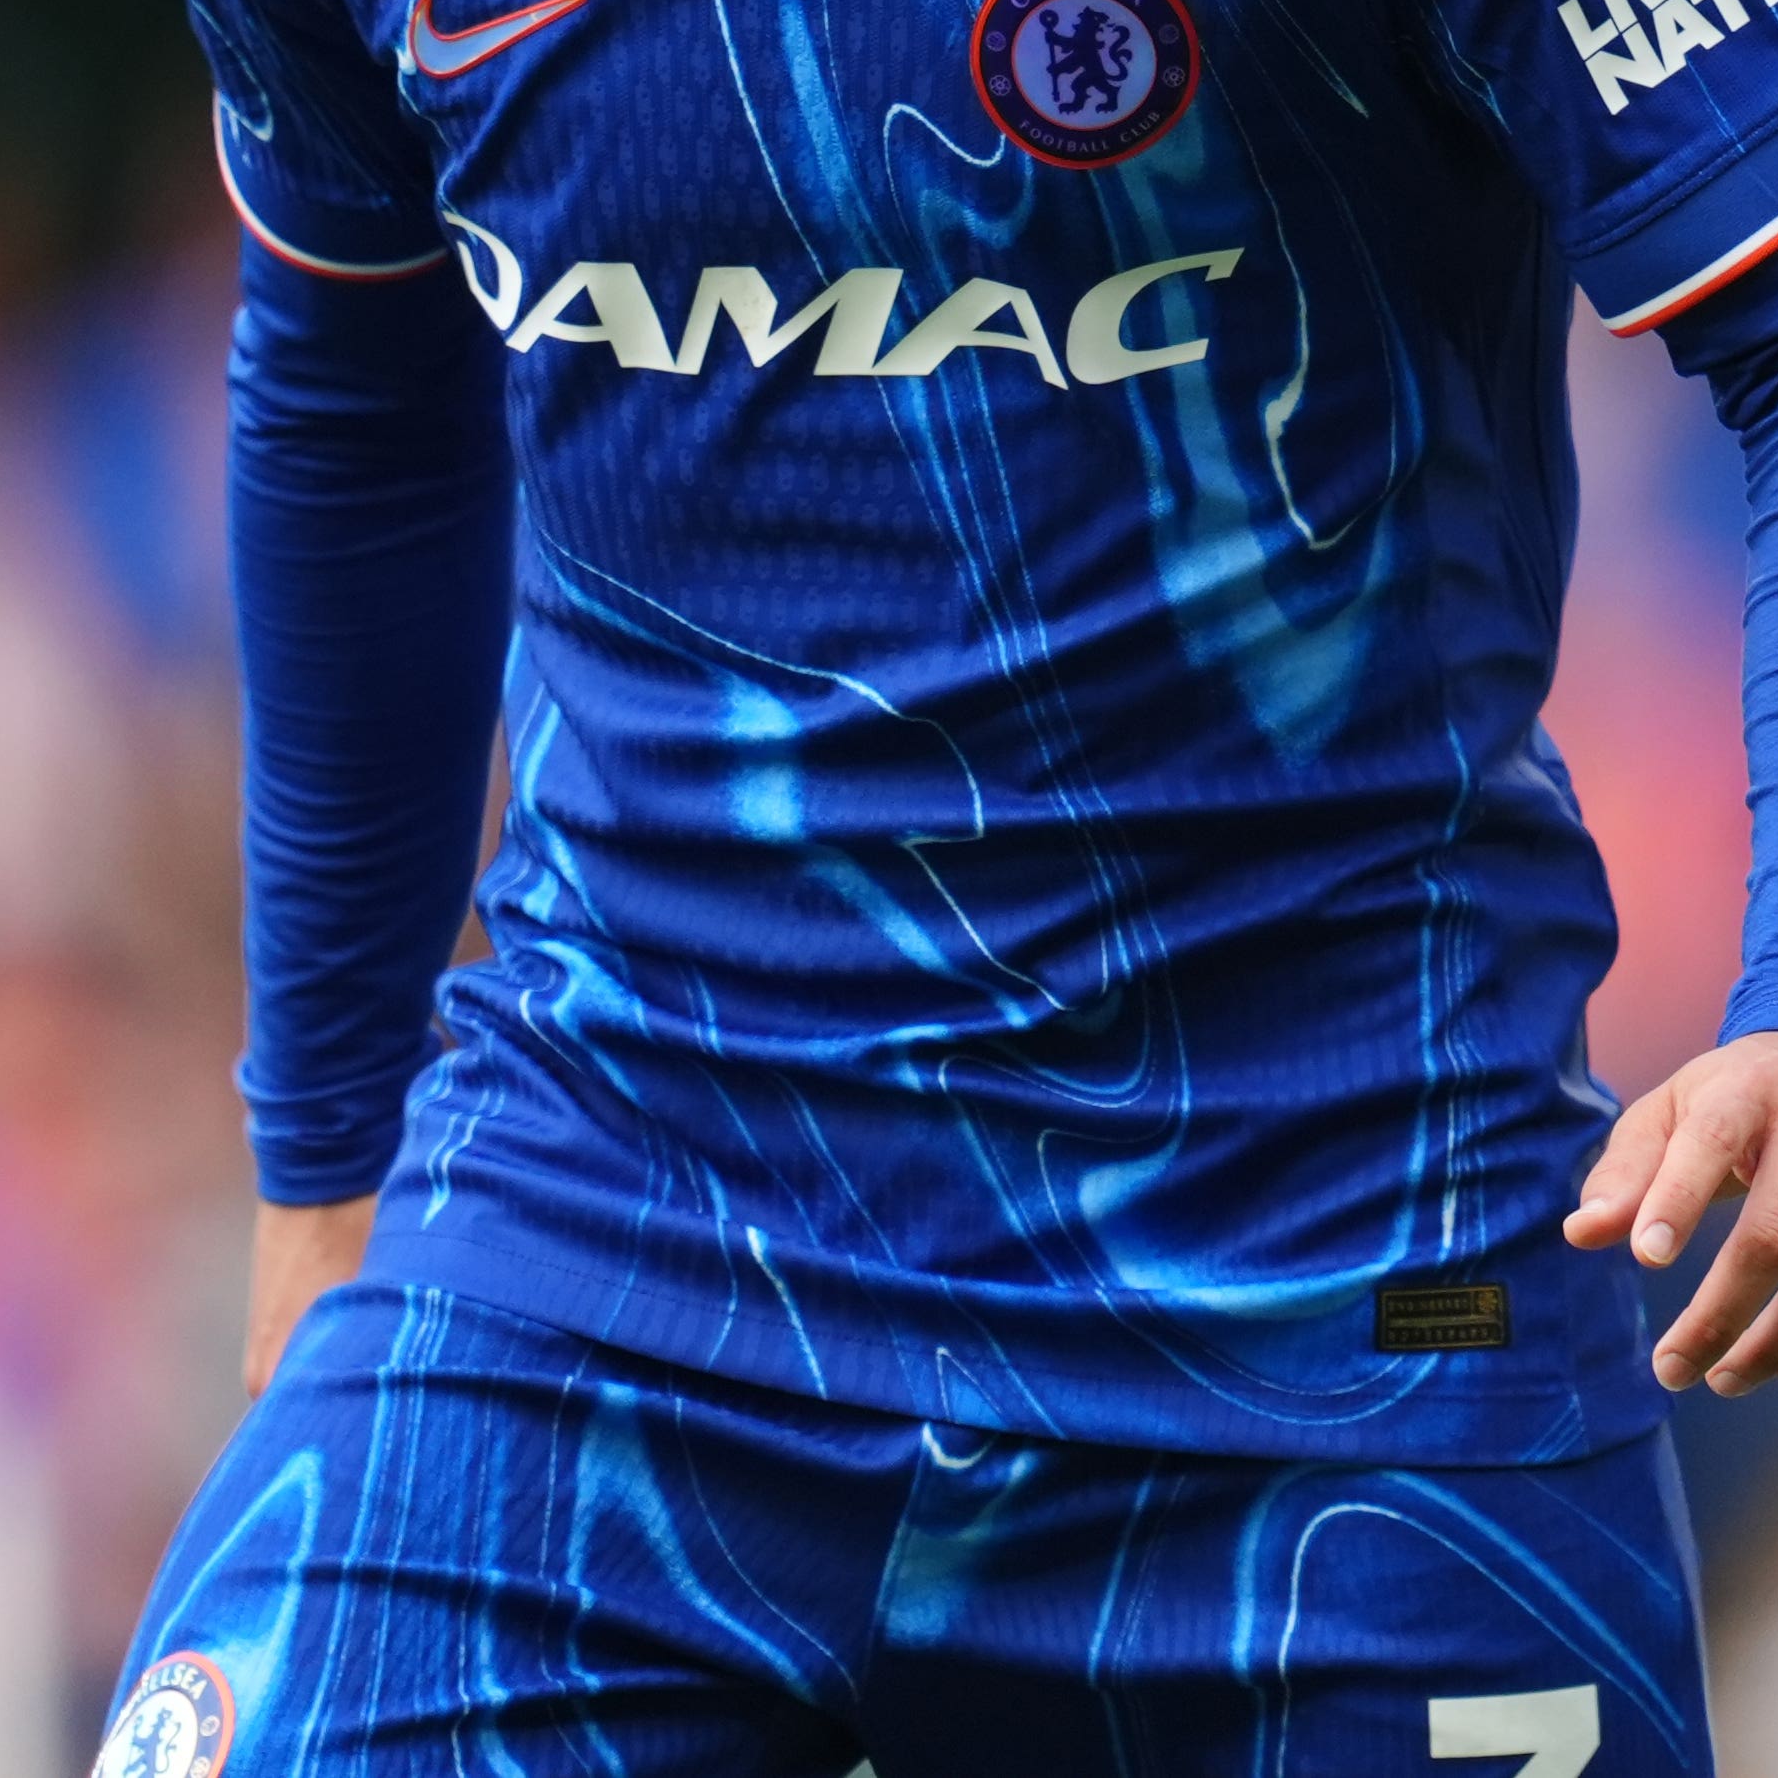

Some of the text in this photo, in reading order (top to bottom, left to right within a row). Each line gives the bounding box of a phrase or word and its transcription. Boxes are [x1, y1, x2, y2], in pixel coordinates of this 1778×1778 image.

[1019, 110, 1161, 153] FOOTBALL CLUB
[442, 210, 1245, 391] DAMAC
